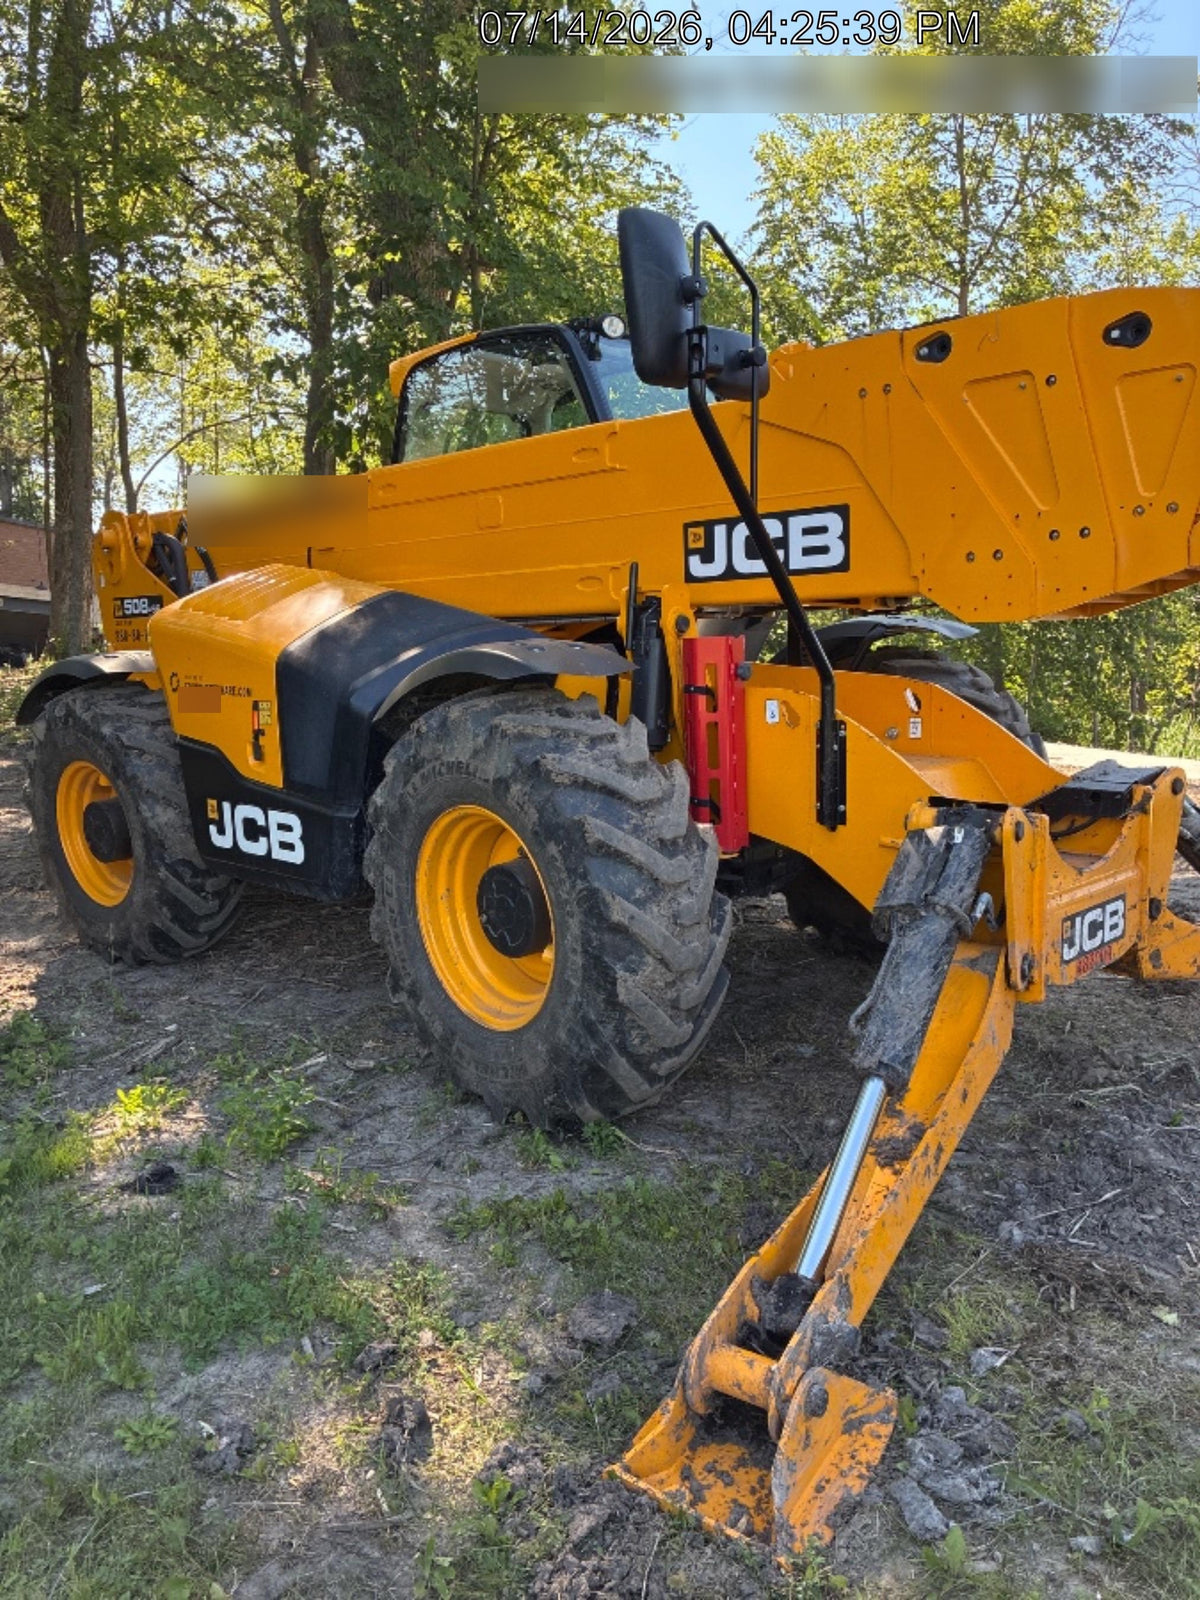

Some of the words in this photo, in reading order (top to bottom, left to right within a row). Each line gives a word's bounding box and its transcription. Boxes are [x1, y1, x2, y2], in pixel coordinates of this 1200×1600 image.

[687, 511, 846, 578] JCB
[208, 801, 305, 865] JCB
[1062, 898, 1125, 961] JCB
